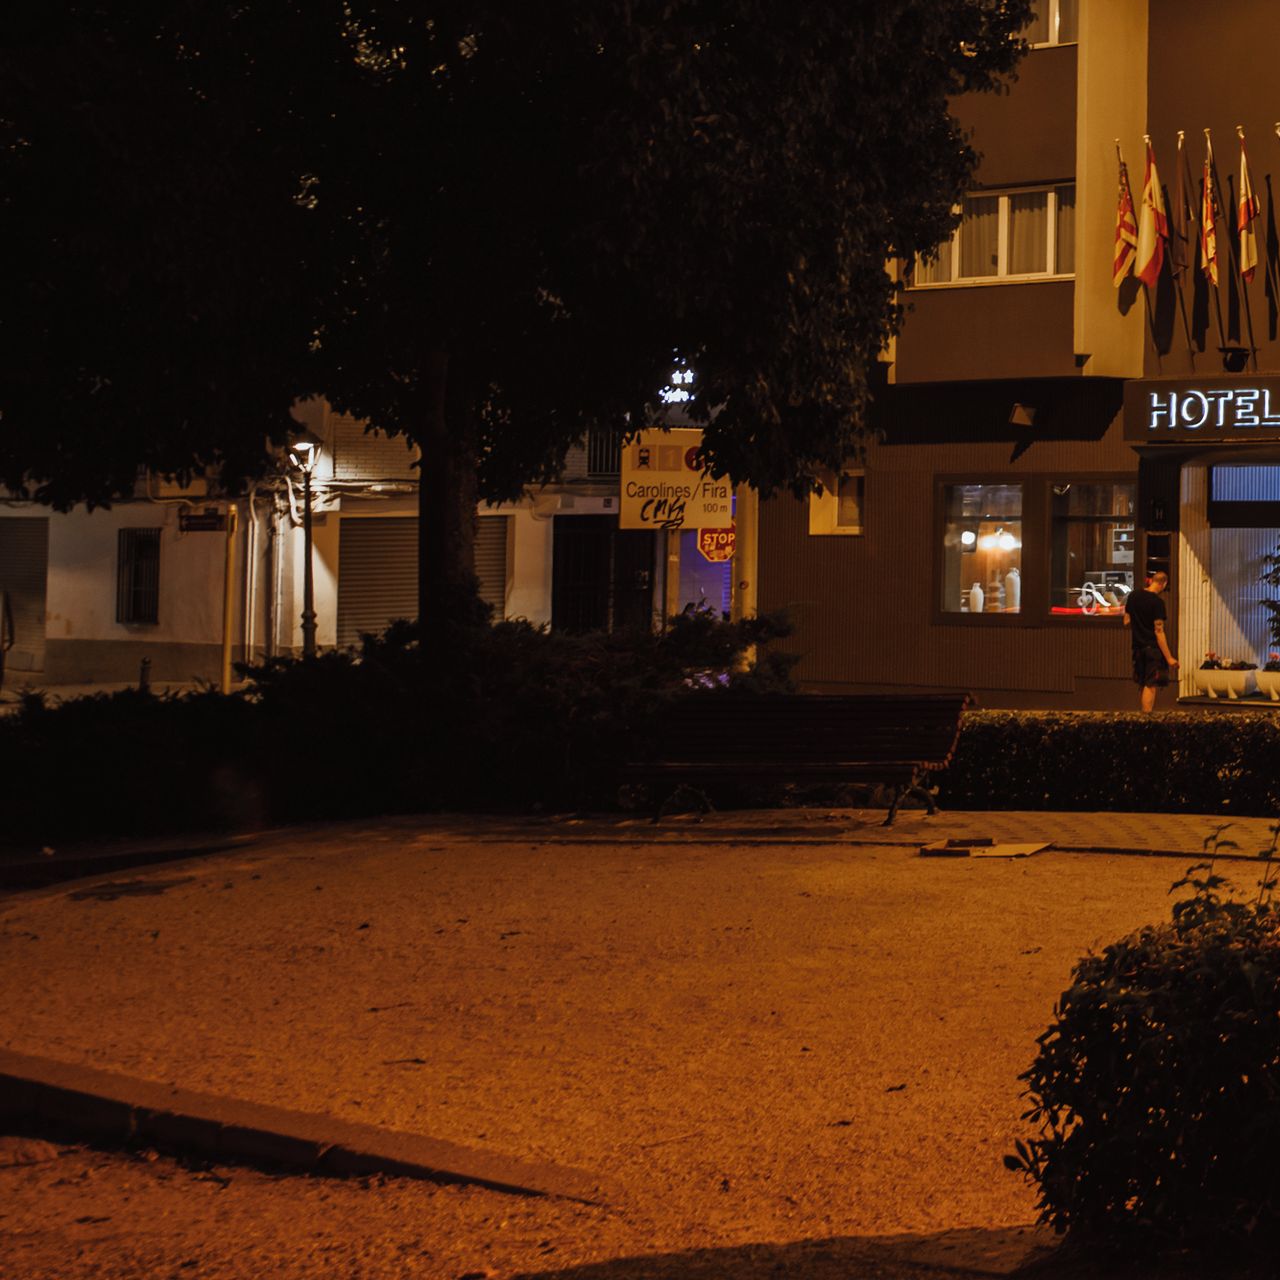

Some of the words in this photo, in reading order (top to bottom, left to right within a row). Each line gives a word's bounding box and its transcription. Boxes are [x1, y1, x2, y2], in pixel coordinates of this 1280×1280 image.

[626, 480, 691, 498] Carolines
[702, 483, 728, 498] Fira
[703, 503, 718, 513] 100
[703, 533, 736, 544] STOP
